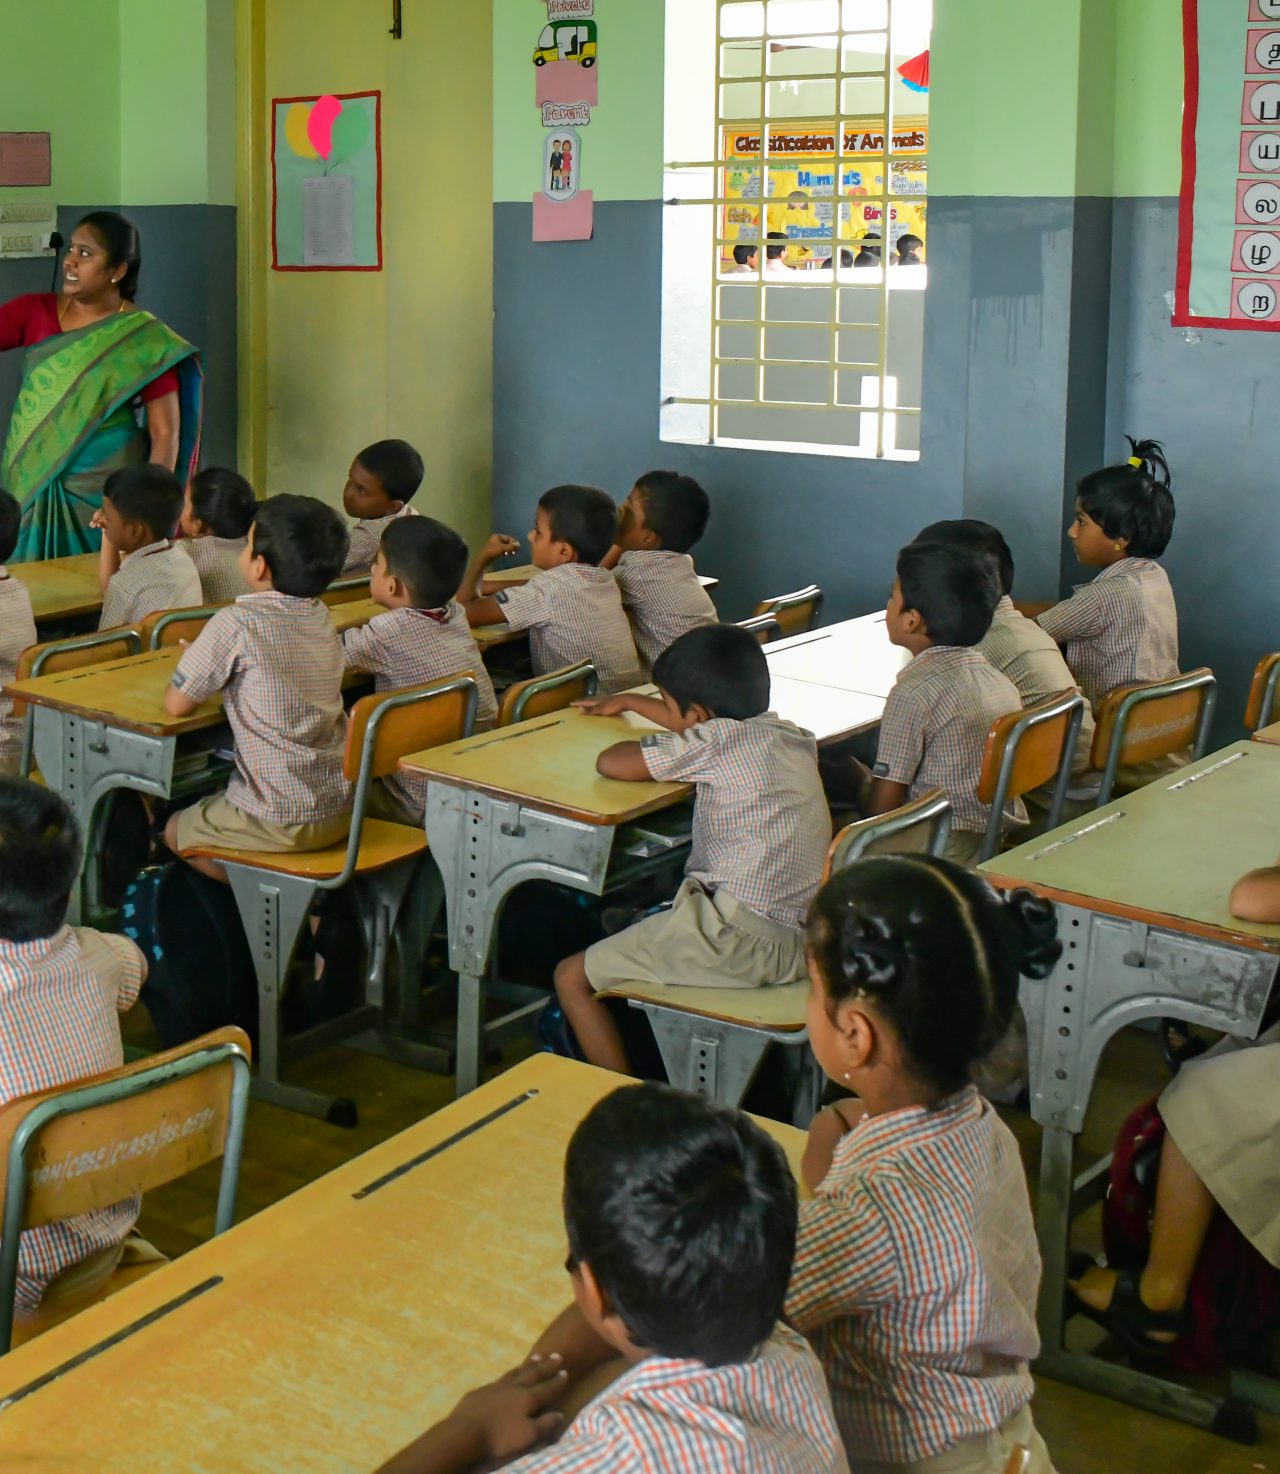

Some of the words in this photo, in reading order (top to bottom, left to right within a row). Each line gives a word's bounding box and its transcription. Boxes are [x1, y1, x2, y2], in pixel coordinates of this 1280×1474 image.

[544, 104, 588, 120] Parent
[736, 133, 835, 151] Clasification
[861, 131, 925, 150] Anmals
[864, 205, 896, 220] Birs
[1255, 199, 1277, 214] ல
[1251, 245, 1271, 266] ழ
[1252, 295, 1269, 314] ற
